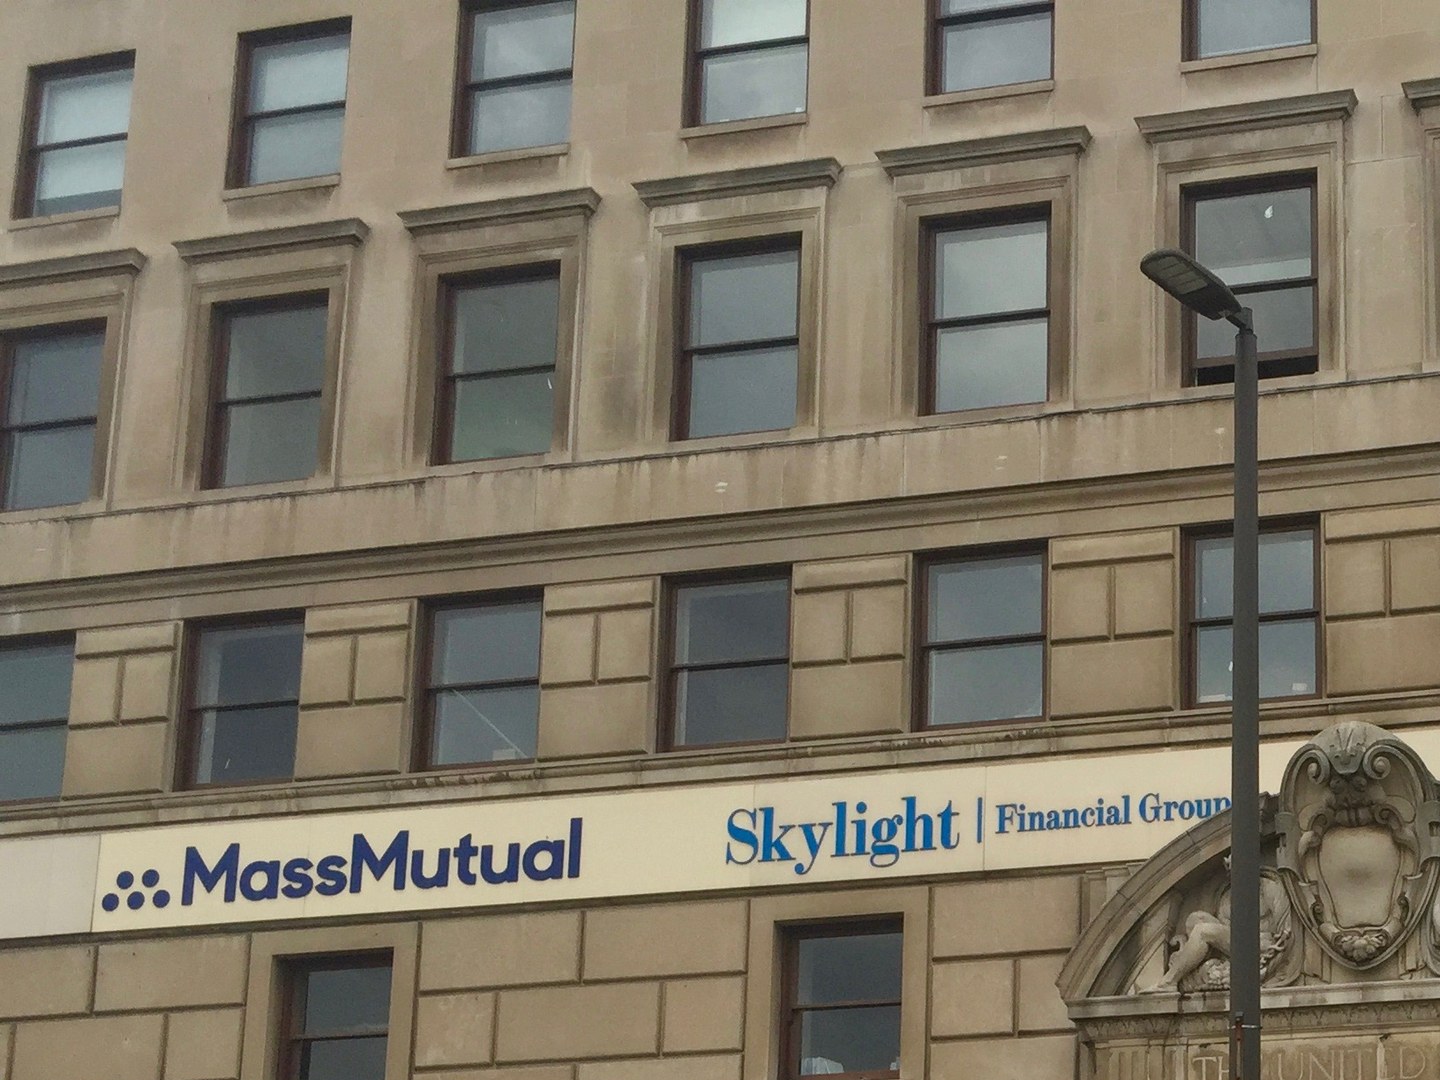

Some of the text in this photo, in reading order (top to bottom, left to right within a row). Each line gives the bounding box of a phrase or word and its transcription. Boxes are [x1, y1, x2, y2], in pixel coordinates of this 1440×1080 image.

[180, 817, 583, 906] MassMutual
[725, 796, 960, 875] Skylight
[995, 795, 1132, 834] Financial
